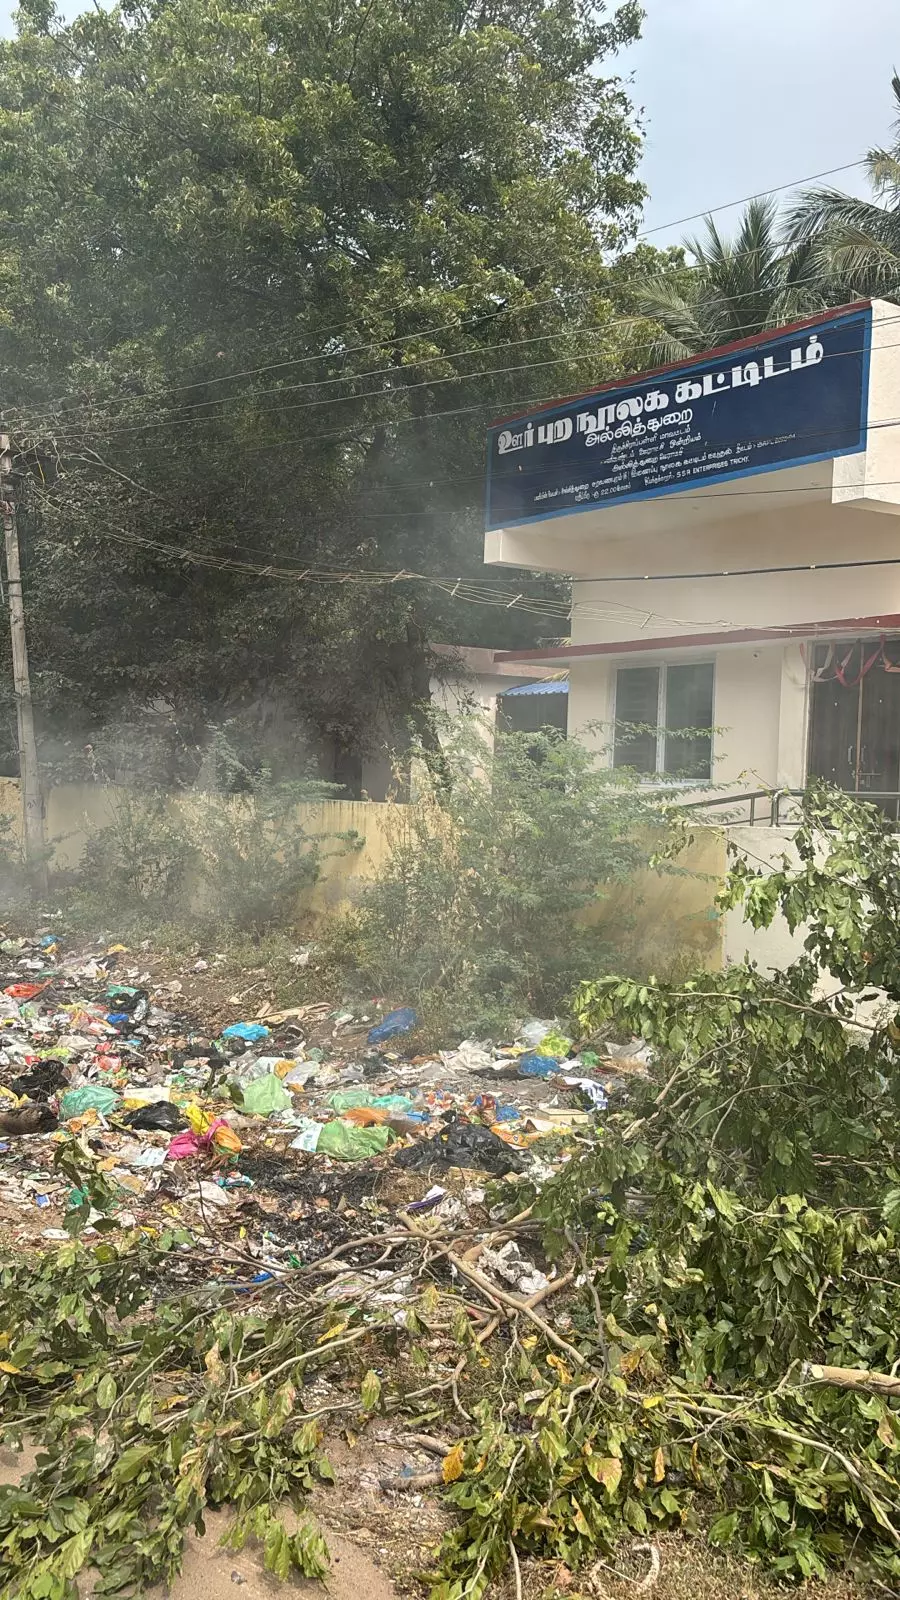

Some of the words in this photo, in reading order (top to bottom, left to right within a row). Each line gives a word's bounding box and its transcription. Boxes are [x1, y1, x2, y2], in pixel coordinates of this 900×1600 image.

[577, 389, 669, 437] நூலக
[675, 335, 824, 404] கட்டிடம்
[585, 408, 693, 447] அல்லித்துறை
[692, 460, 729, 474] ENTERPRISES
